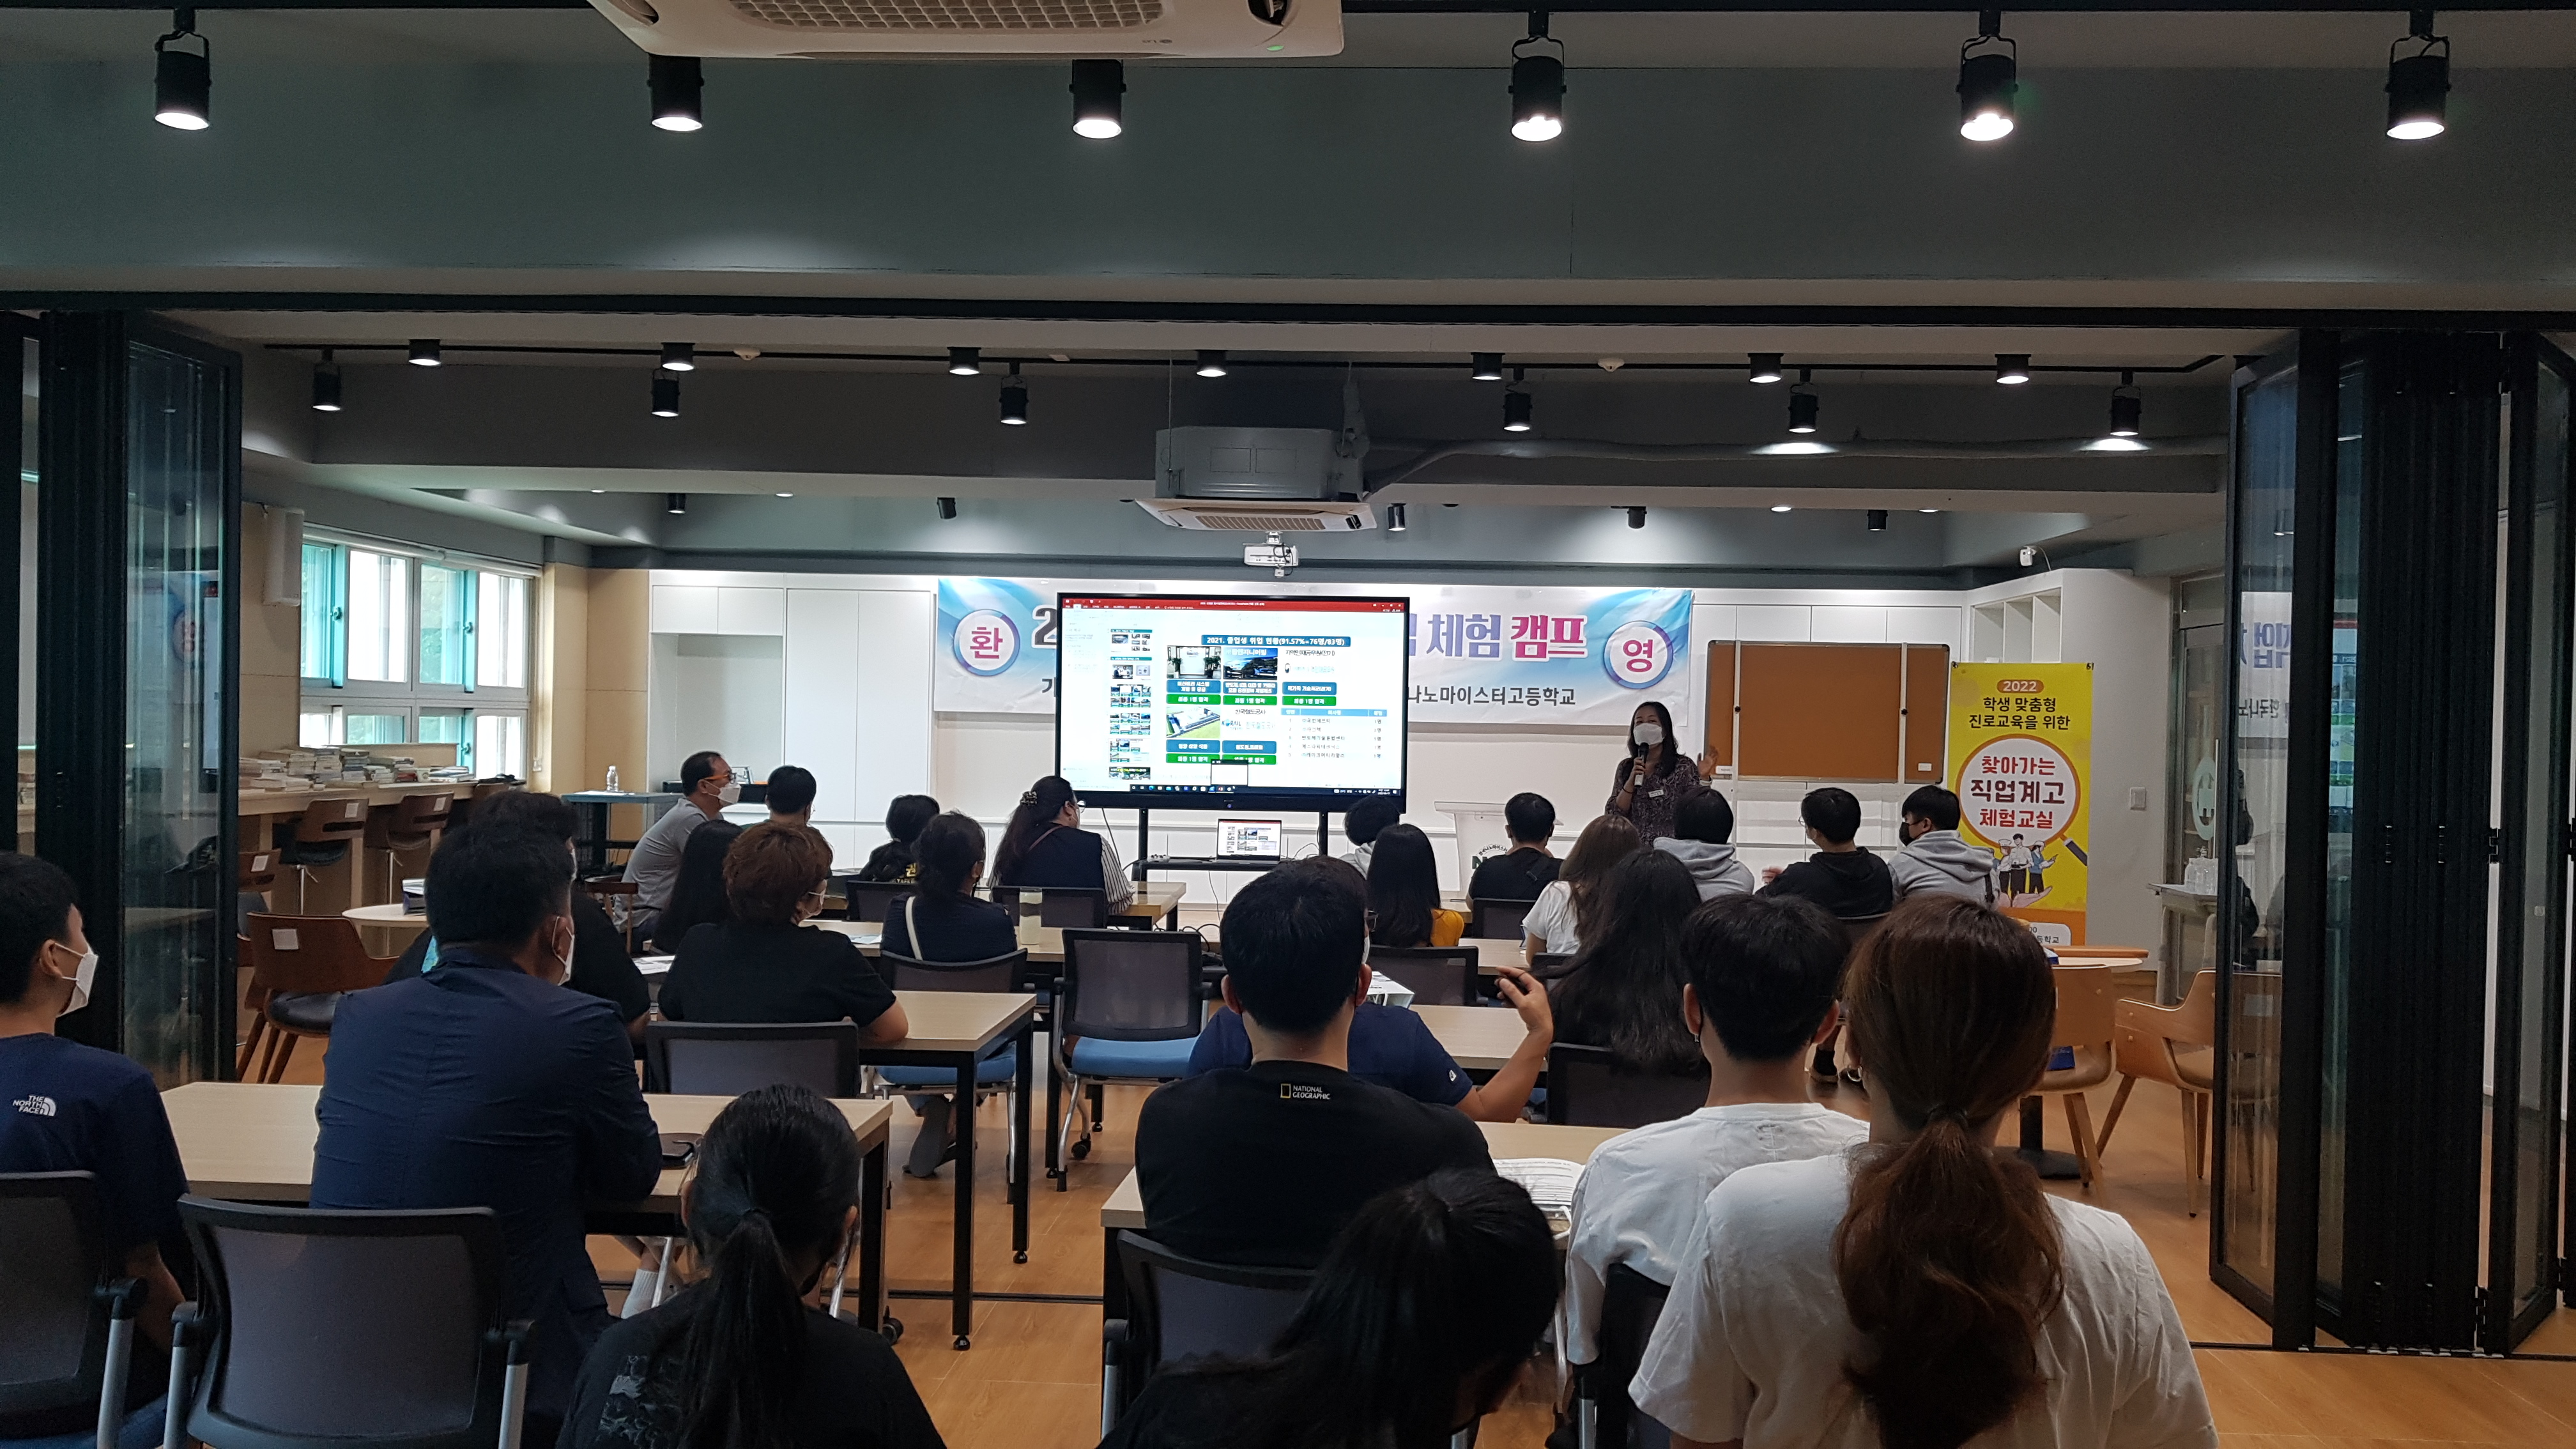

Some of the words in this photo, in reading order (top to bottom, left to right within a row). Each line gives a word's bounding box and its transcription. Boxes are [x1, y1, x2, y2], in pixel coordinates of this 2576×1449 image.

[970, 627, 1003, 659] 환
[1426, 614, 1501, 657] 체험
[1510, 615, 1585, 658] 캠프
[1623, 639, 1653, 672] 영
[1408, 685, 1576, 707] 나노마이스터고등학교
[2003, 680, 2037, 692] 2022
[1983, 697, 2011, 712] 학생
[2015, 697, 2057, 712] 맞춤형
[1969, 714, 2038, 730] 진로교육을
[2043, 716, 2071, 730] 위한
[1982, 756, 2056, 775] 찾아가는
[1971, 779, 2065, 804] 직업계고
[1979, 808, 2053, 829] 체험교실
[13, 1100, 43, 1108] NORTH
